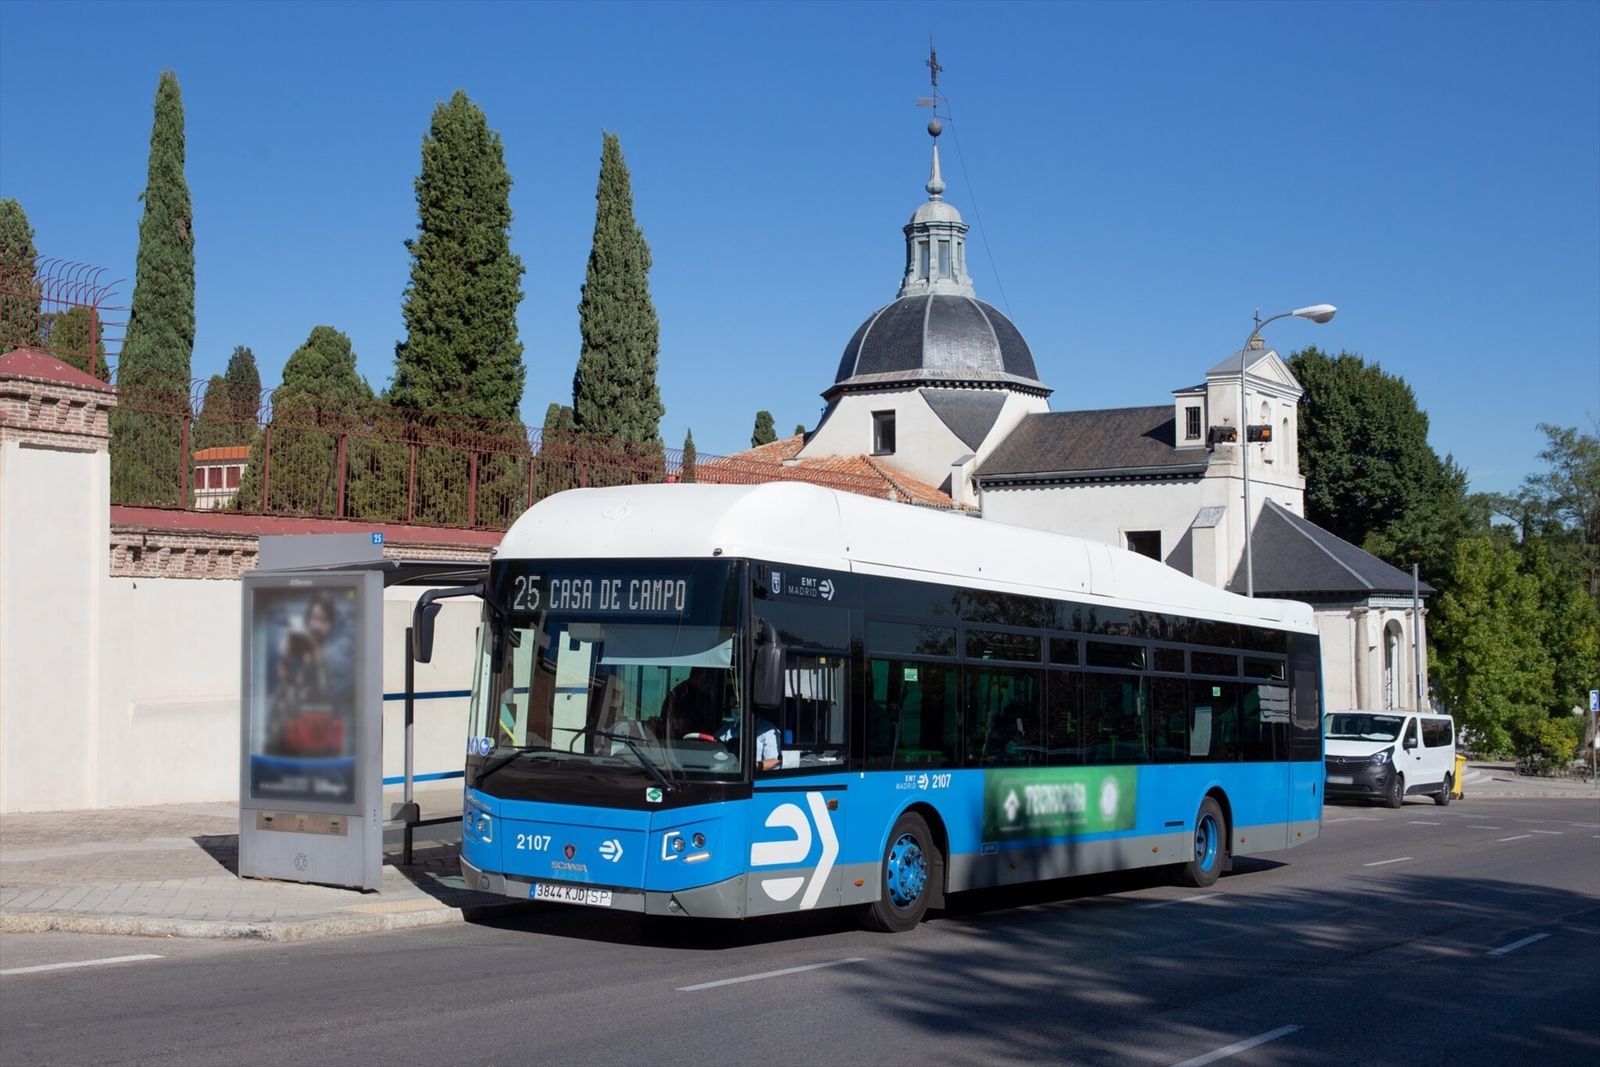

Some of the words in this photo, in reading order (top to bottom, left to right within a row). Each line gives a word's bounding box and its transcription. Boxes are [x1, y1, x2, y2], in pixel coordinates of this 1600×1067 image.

[373, 533, 382, 543] 25
[801, 576, 817, 587] EMT
[513, 575, 541, 611] 25
[549, 578, 593, 610] CASA
[599, 579, 622, 610] DE
[628, 579, 687, 611] CAMPO
[788, 585, 818, 598] MADRID
[905, 774, 916, 782] EMT
[931, 773, 952, 789] 2107
[895, 782, 917, 790] MADRID
[516, 833, 552, 852] 2107
[551, 860, 588, 873] SCANIA
[537, 884, 562, 899] 3844
[565, 887, 585, 901] KJD
[590, 889, 609, 903] SP
